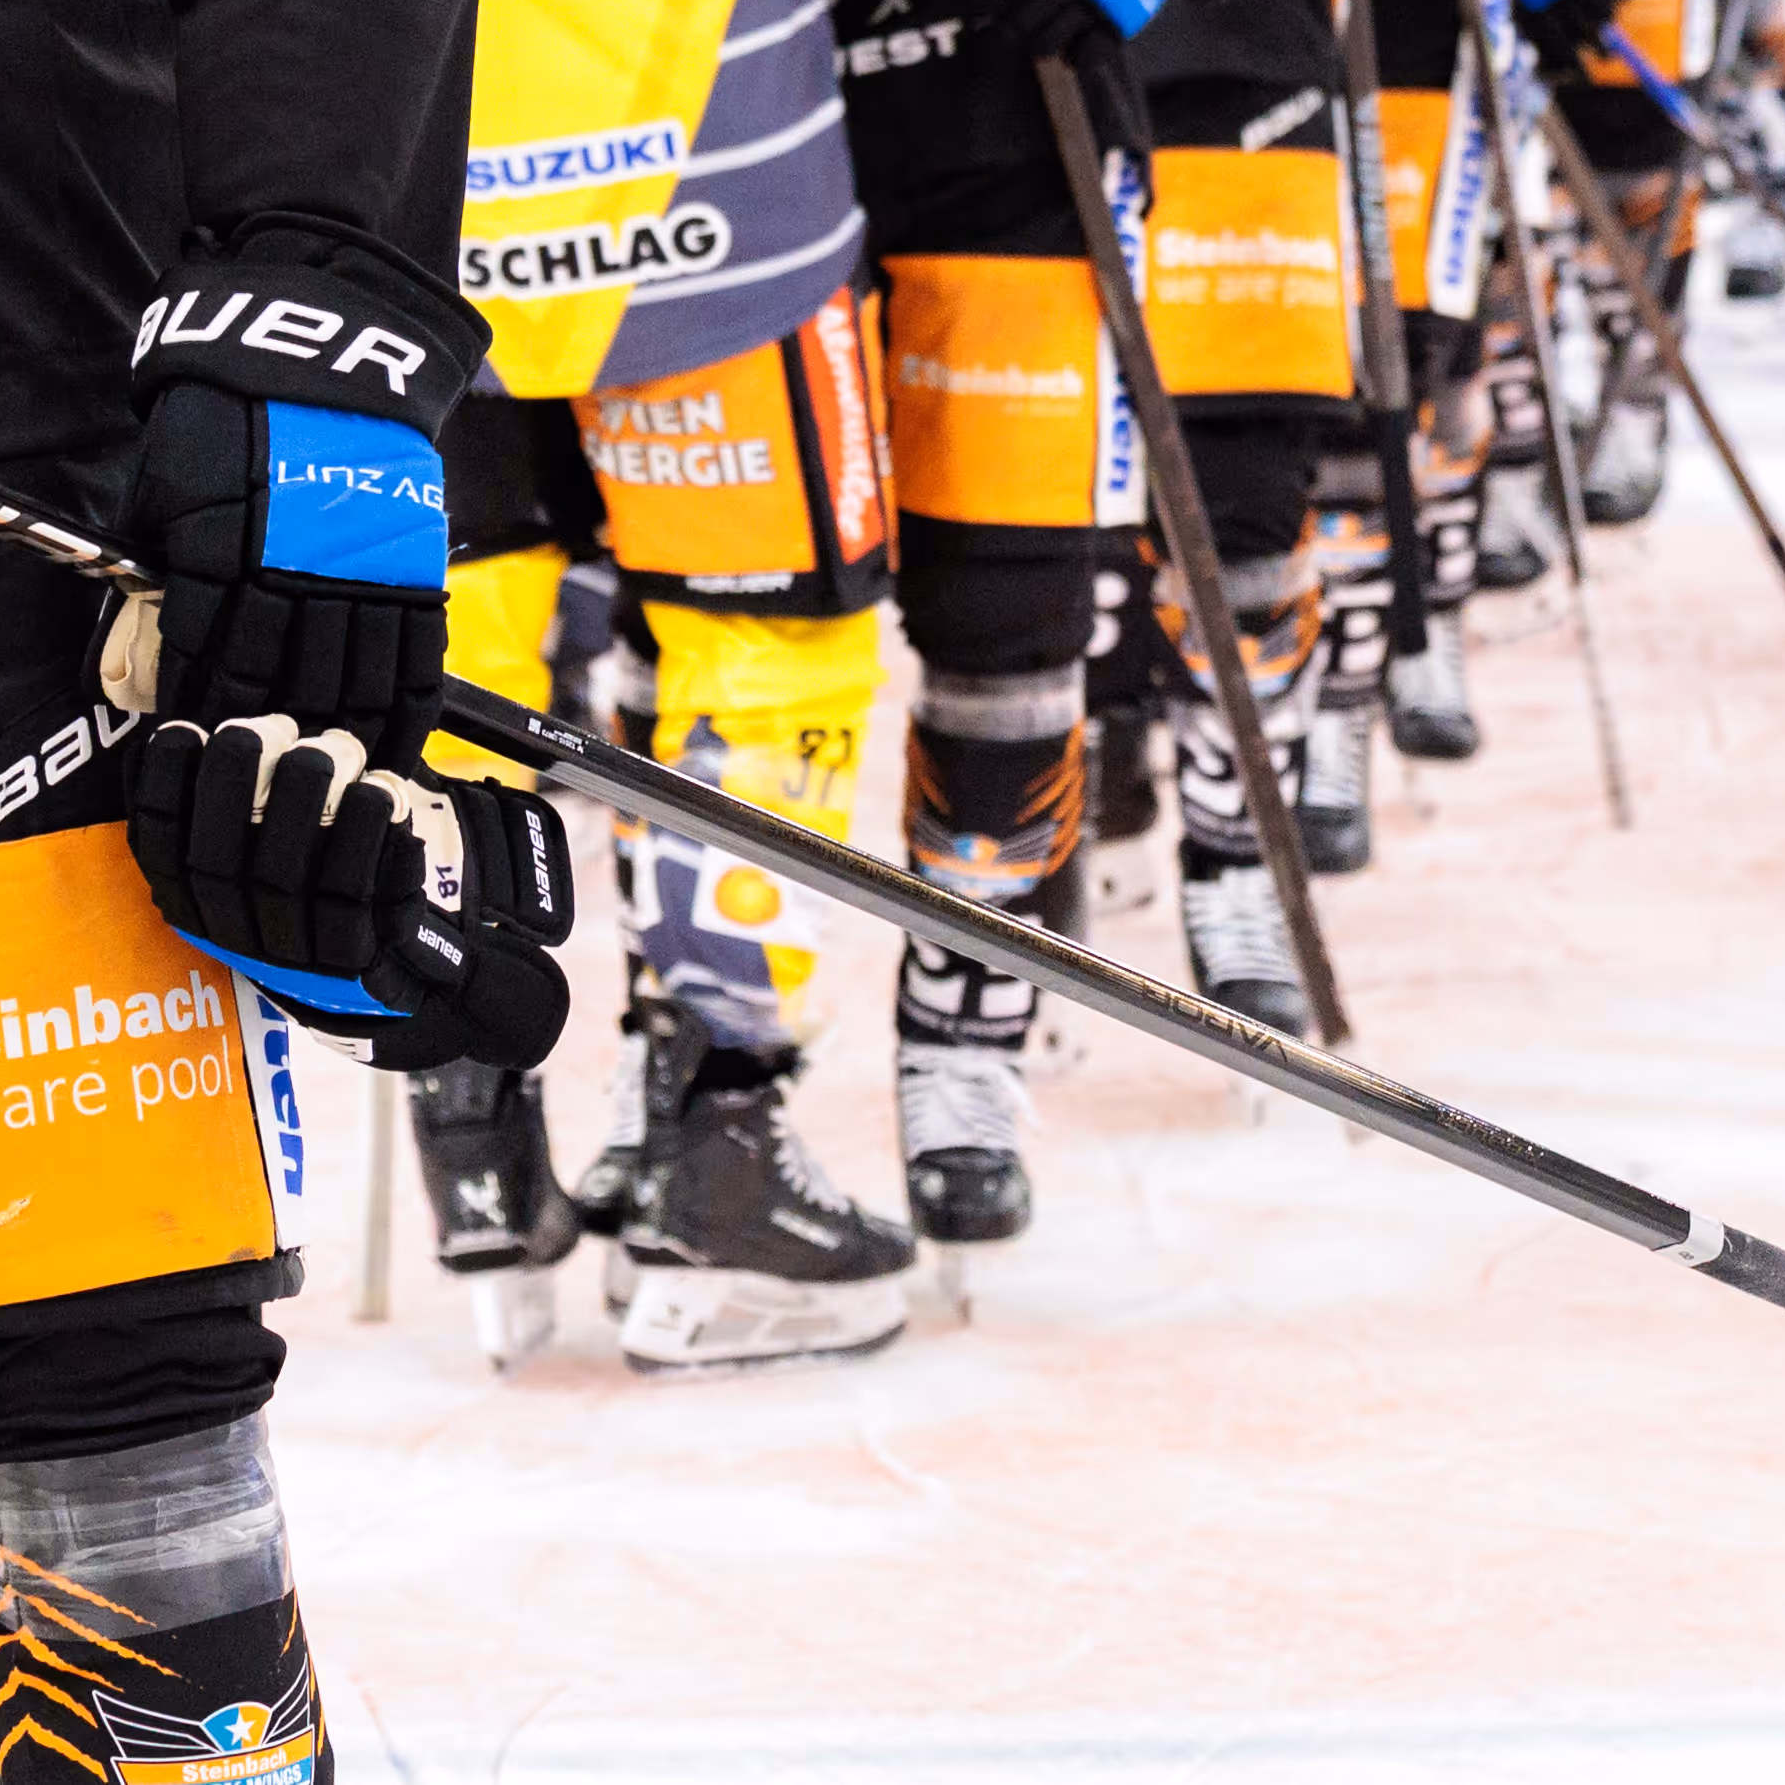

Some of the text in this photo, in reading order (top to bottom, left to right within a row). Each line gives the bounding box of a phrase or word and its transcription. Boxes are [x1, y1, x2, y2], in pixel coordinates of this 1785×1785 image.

[464, 131, 677, 194] SUZUKI
[463, 210, 721, 292] SCHLAG
[278, 461, 445, 511] LINZ AG
[435, 864, 460, 900] 81
[525, 809, 554, 913] BAUER
[417, 924, 464, 966] BAUER
[3, 1069, 107, 1127] are
[133, 1035, 234, 1122] pool
[181, 1749, 287, 1784] Steinbach
